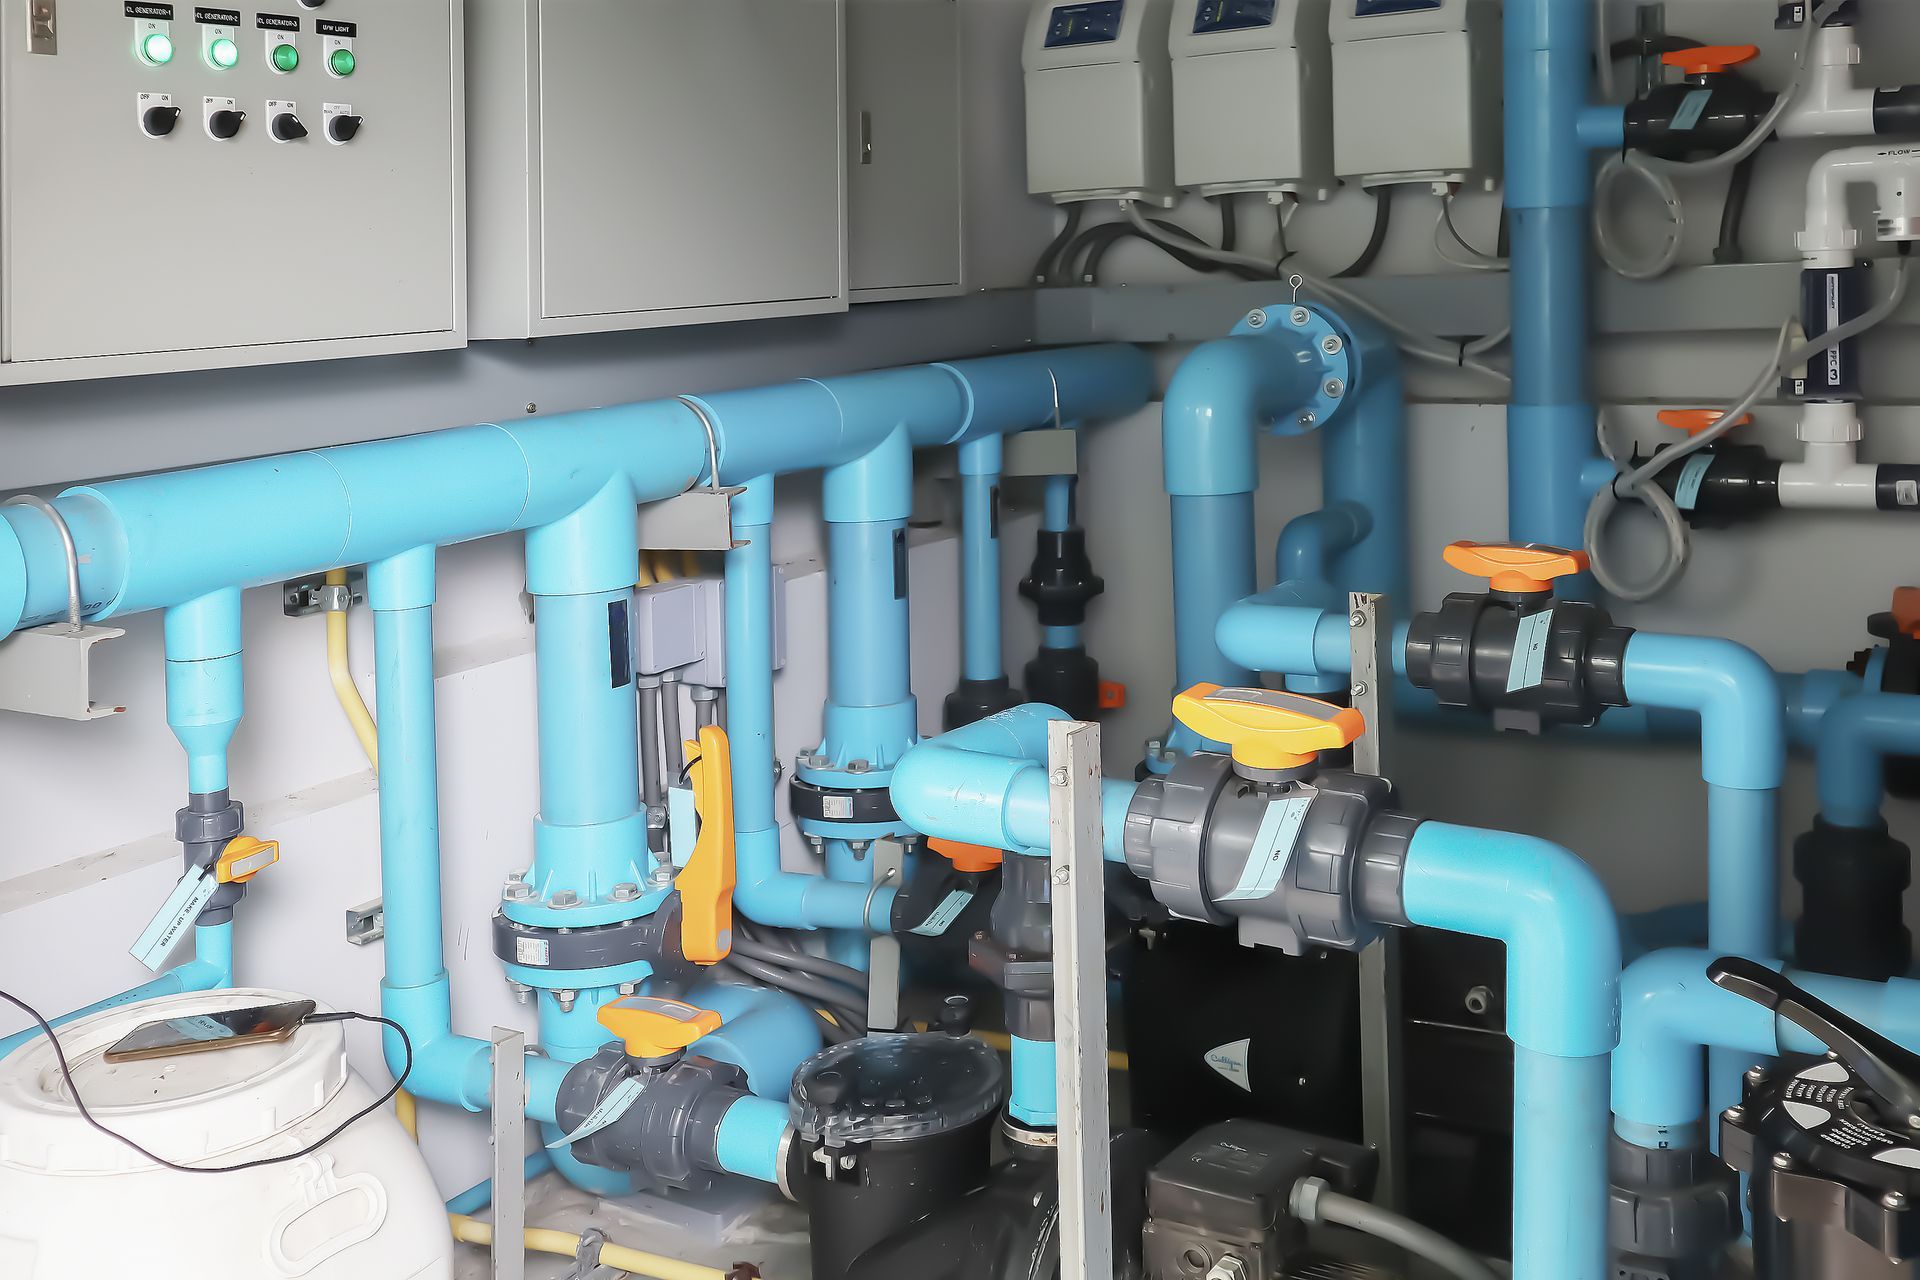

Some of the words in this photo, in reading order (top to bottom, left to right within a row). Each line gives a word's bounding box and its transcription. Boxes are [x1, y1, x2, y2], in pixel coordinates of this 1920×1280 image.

[135, 6, 171, 16] GENERATOR-1
[204, 12, 238, 22] GENERATOR-2
[265, 18, 298, 27] GENERATOR-3
[1829, 350, 1837, 366] PPC
[1829, 369, 1838, 380] 3
[184, 896, 199, 914] MAKE
[176, 916, 184, 926] UP
[160, 925, 178, 947] WATER
[1831, 1128, 1868, 1146] CERRADO
[1840, 1119, 1894, 1145] GESCHLOSSEN
[1842, 1127, 1872, 1142] CHIUSO
[1820, 1134, 1851, 1149] CLOSED
